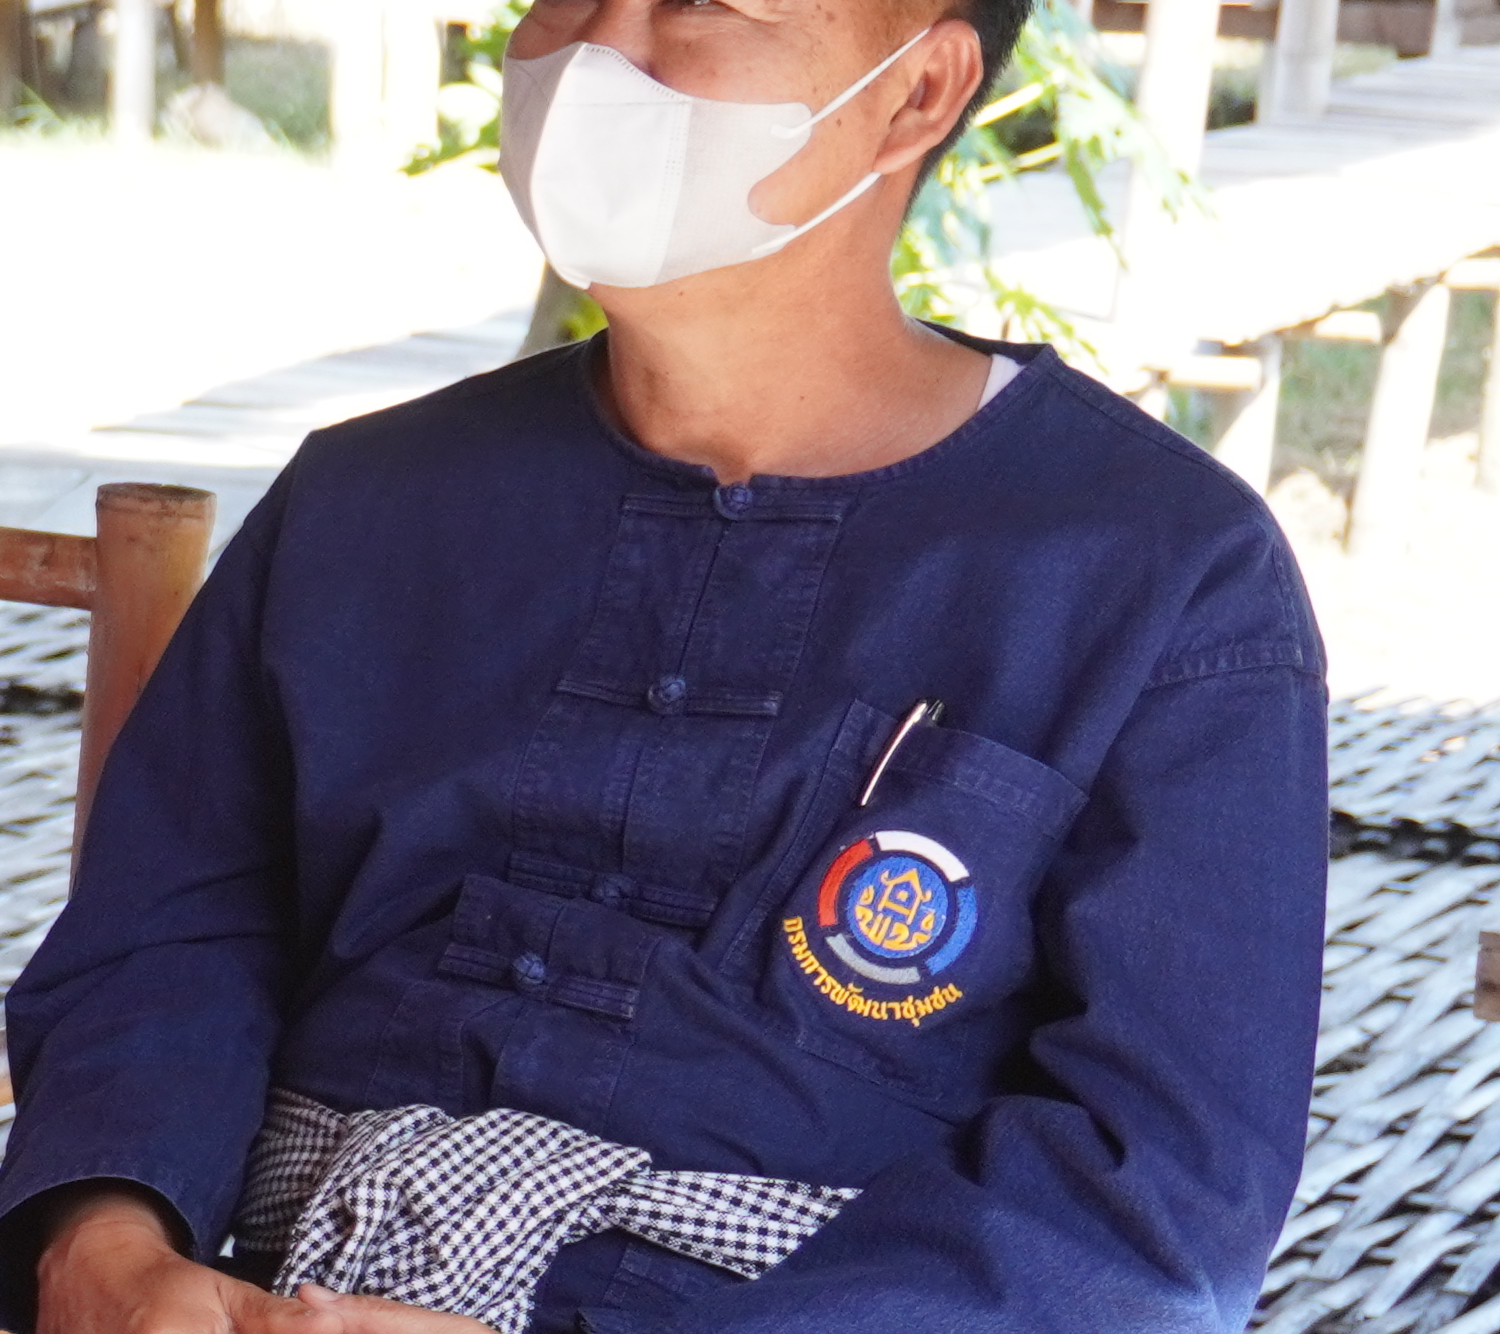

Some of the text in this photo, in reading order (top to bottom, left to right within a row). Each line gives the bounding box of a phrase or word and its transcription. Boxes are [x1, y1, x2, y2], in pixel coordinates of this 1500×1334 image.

[783, 916, 963, 1027] กรมการพัฒนาชุมชน
